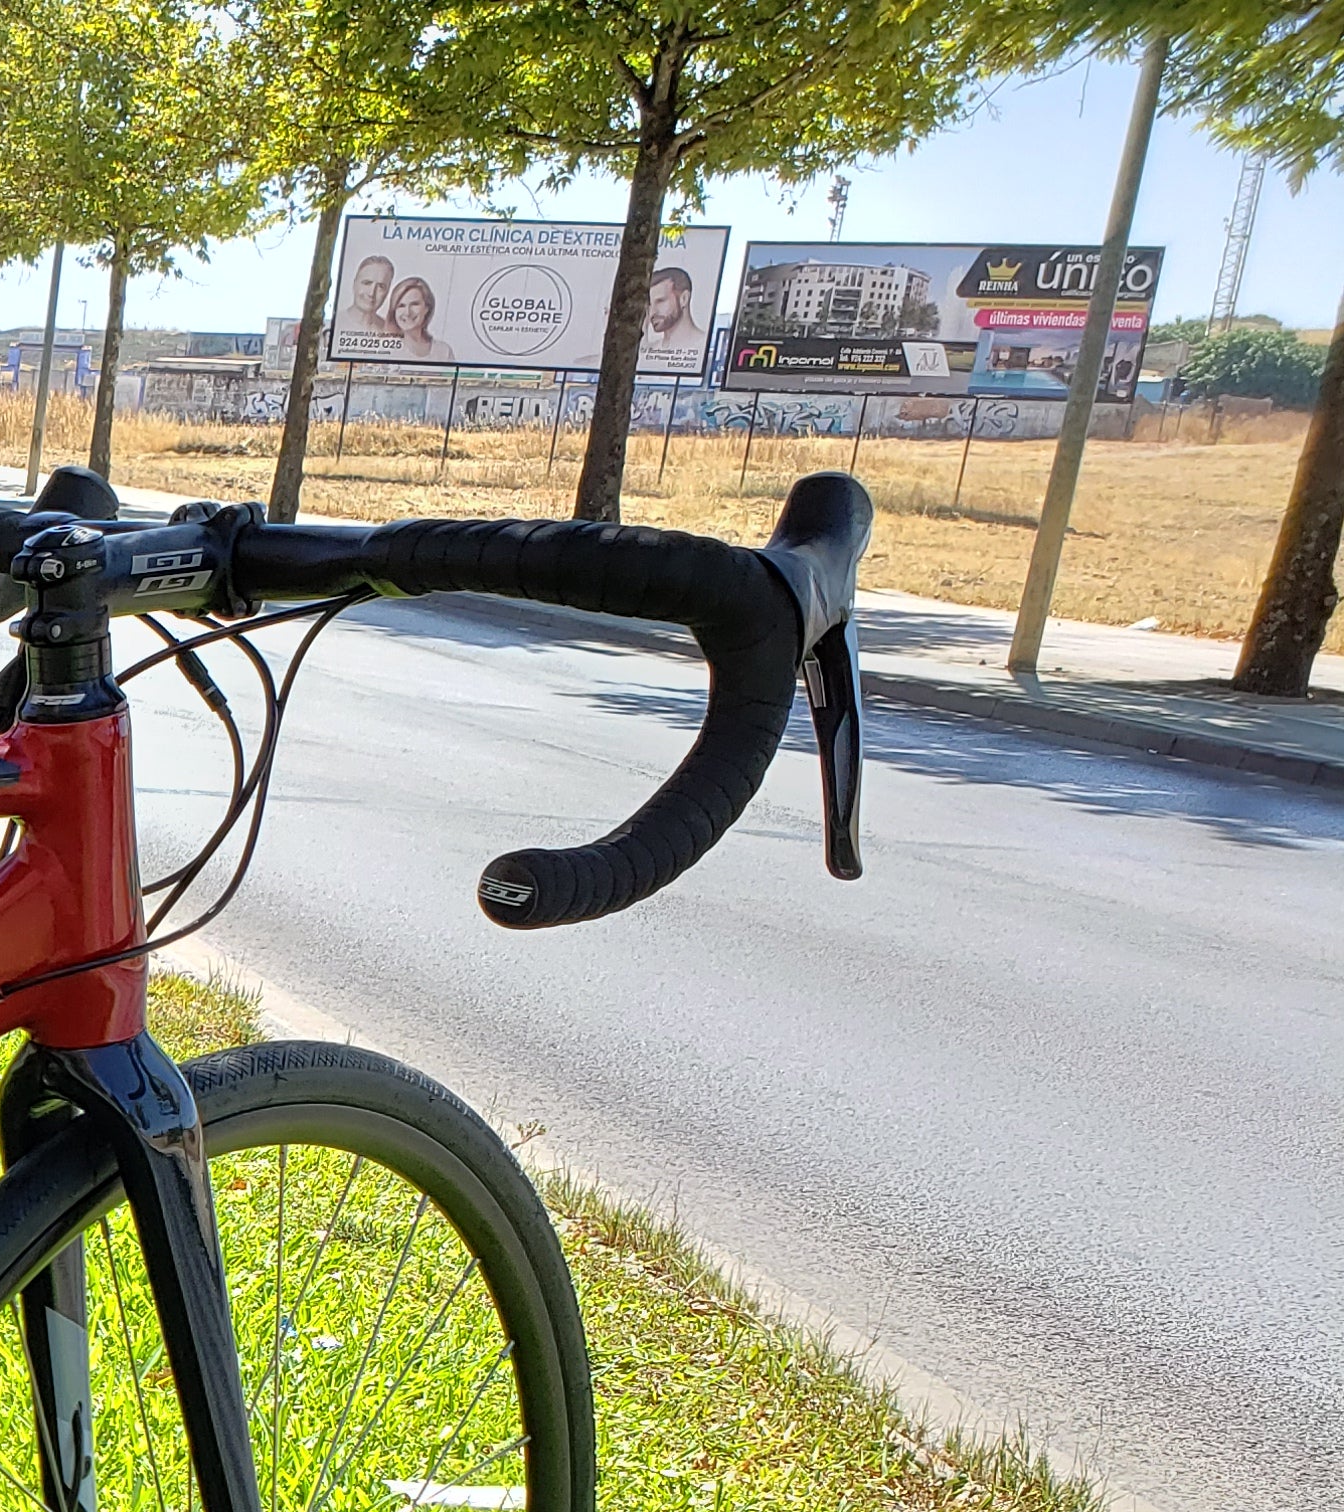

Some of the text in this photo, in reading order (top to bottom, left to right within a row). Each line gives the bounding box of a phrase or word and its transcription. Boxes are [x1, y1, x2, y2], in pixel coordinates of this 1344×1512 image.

[383, 226, 402, 240] LA
[407, 227, 465, 242] MAYOR
[469, 226, 534, 244] CLÍNICA
[425, 244, 462, 253] CAPILAR
[463, 244, 470, 253] Y
[470, 244, 511, 254] ESTÉTICA
[512, 247, 533, 255] CON
[535, 248, 546, 256] LA
[548, 247, 579, 257] ÚLTIMA
[1066, 254, 1083, 263] un
[1037, 251, 1153, 293] únio
[488, 297, 557, 311] GLOBAL
[479, 310, 562, 324] CORPORE
[989, 310, 1142, 328] últimas viviendas venta
[339, 337, 402, 349] 924 025 025
